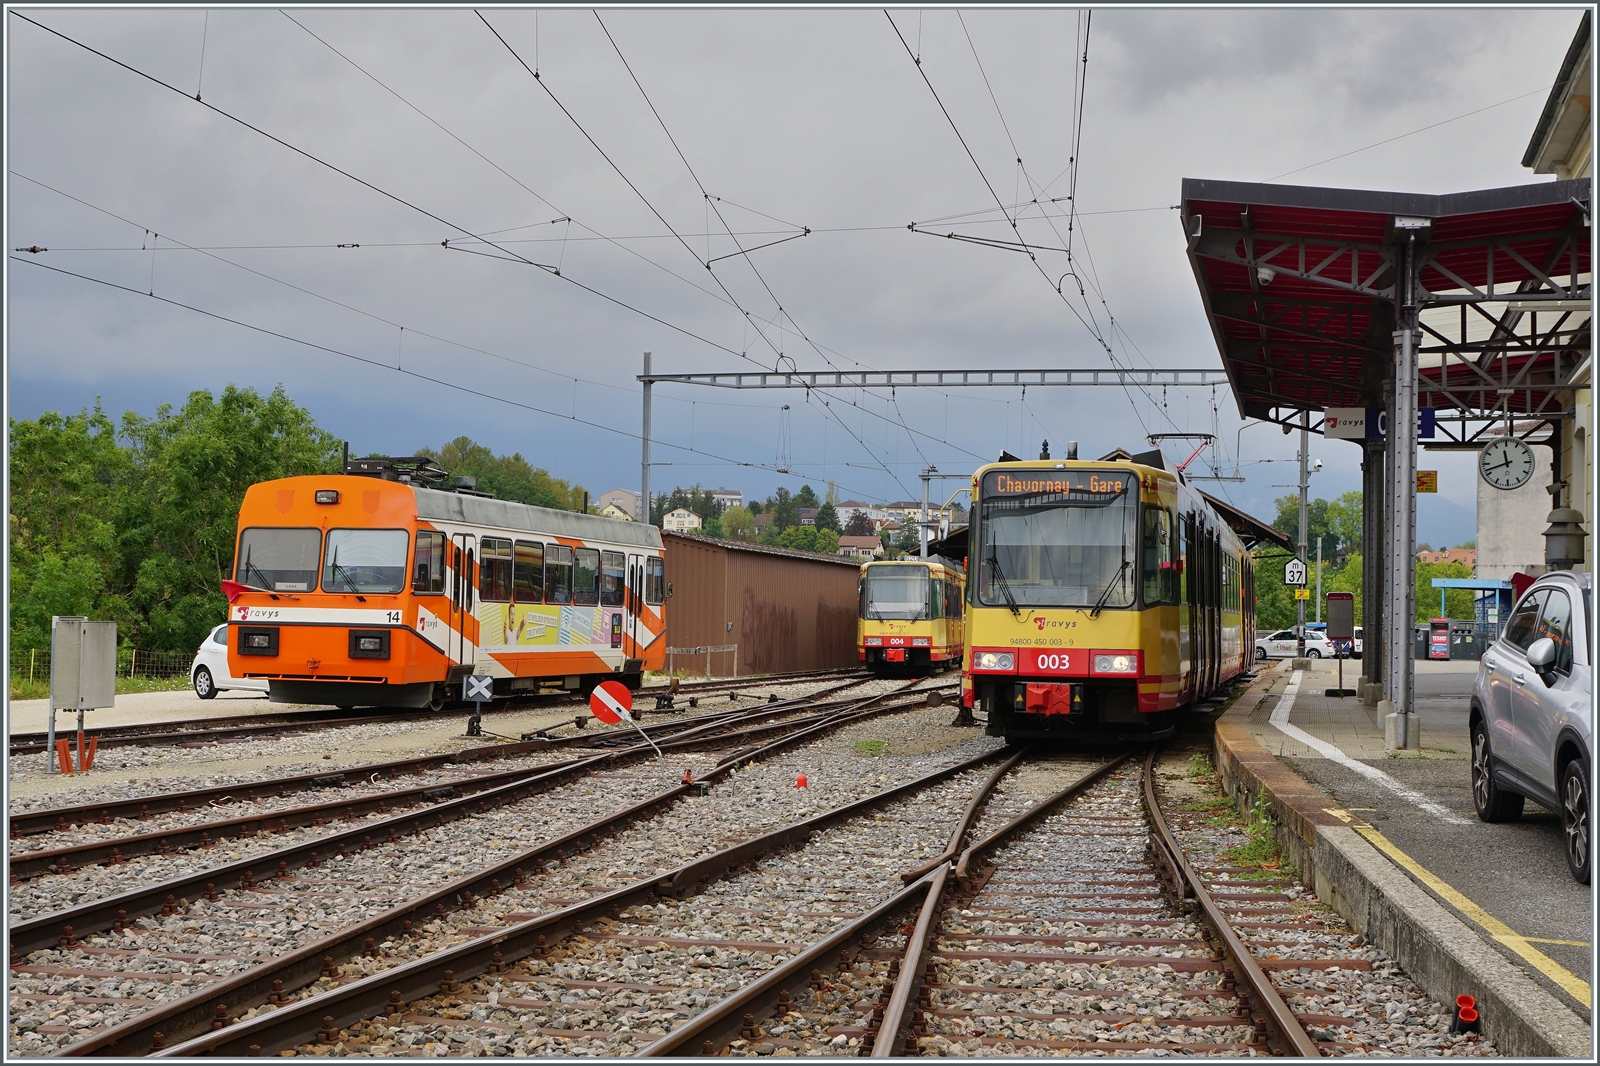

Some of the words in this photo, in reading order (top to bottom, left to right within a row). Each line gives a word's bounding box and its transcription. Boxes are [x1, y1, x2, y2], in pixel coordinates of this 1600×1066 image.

[997, 475, 1070, 494] Chavornay
[1089, 475, 1122, 493] Gare
[1288, 570, 1302, 583] 37
[386, 611, 400, 623] 14
[1049, 638, 1062, 646] 003
[1037, 654, 1070, 669] 003
